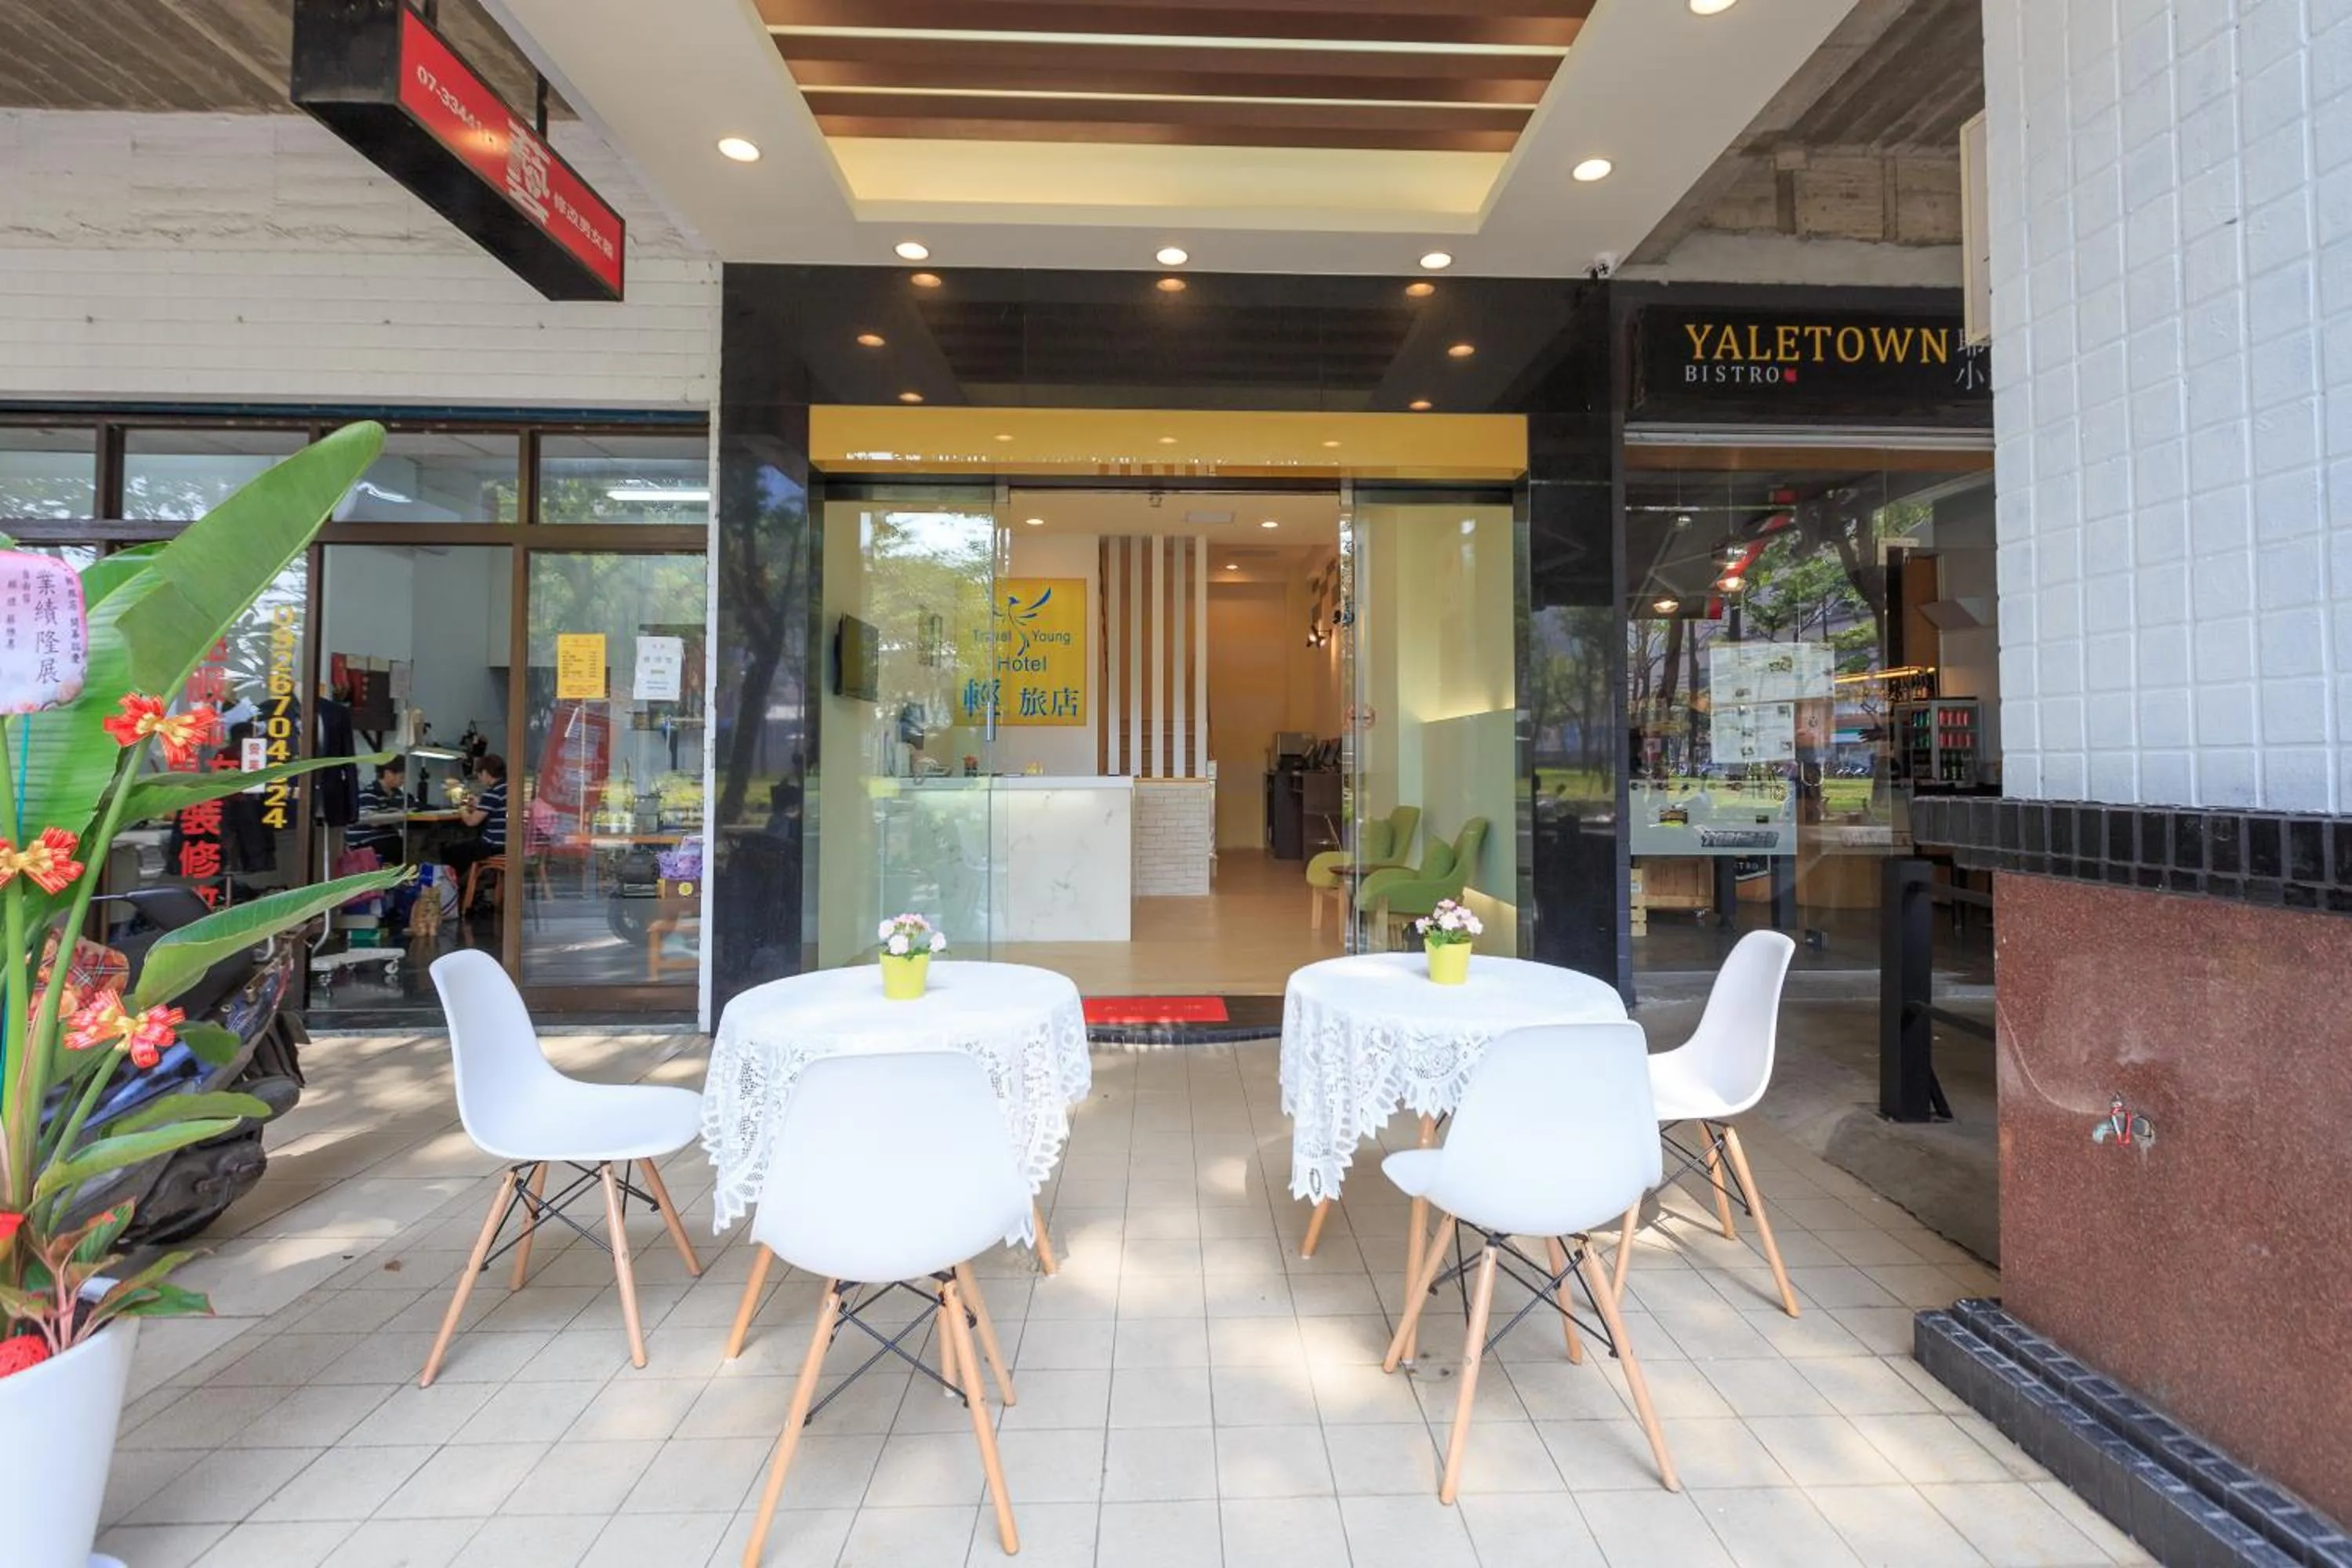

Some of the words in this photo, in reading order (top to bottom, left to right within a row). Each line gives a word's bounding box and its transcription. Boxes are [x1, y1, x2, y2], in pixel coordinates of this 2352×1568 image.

[1684, 324, 1951, 364] YALETOWN
[1685, 365, 1780, 383] BISTRO
[1032, 629, 1071, 645] Young
[996, 655, 1047, 672] Hotel
[261, 603, 295, 829] 092670424
